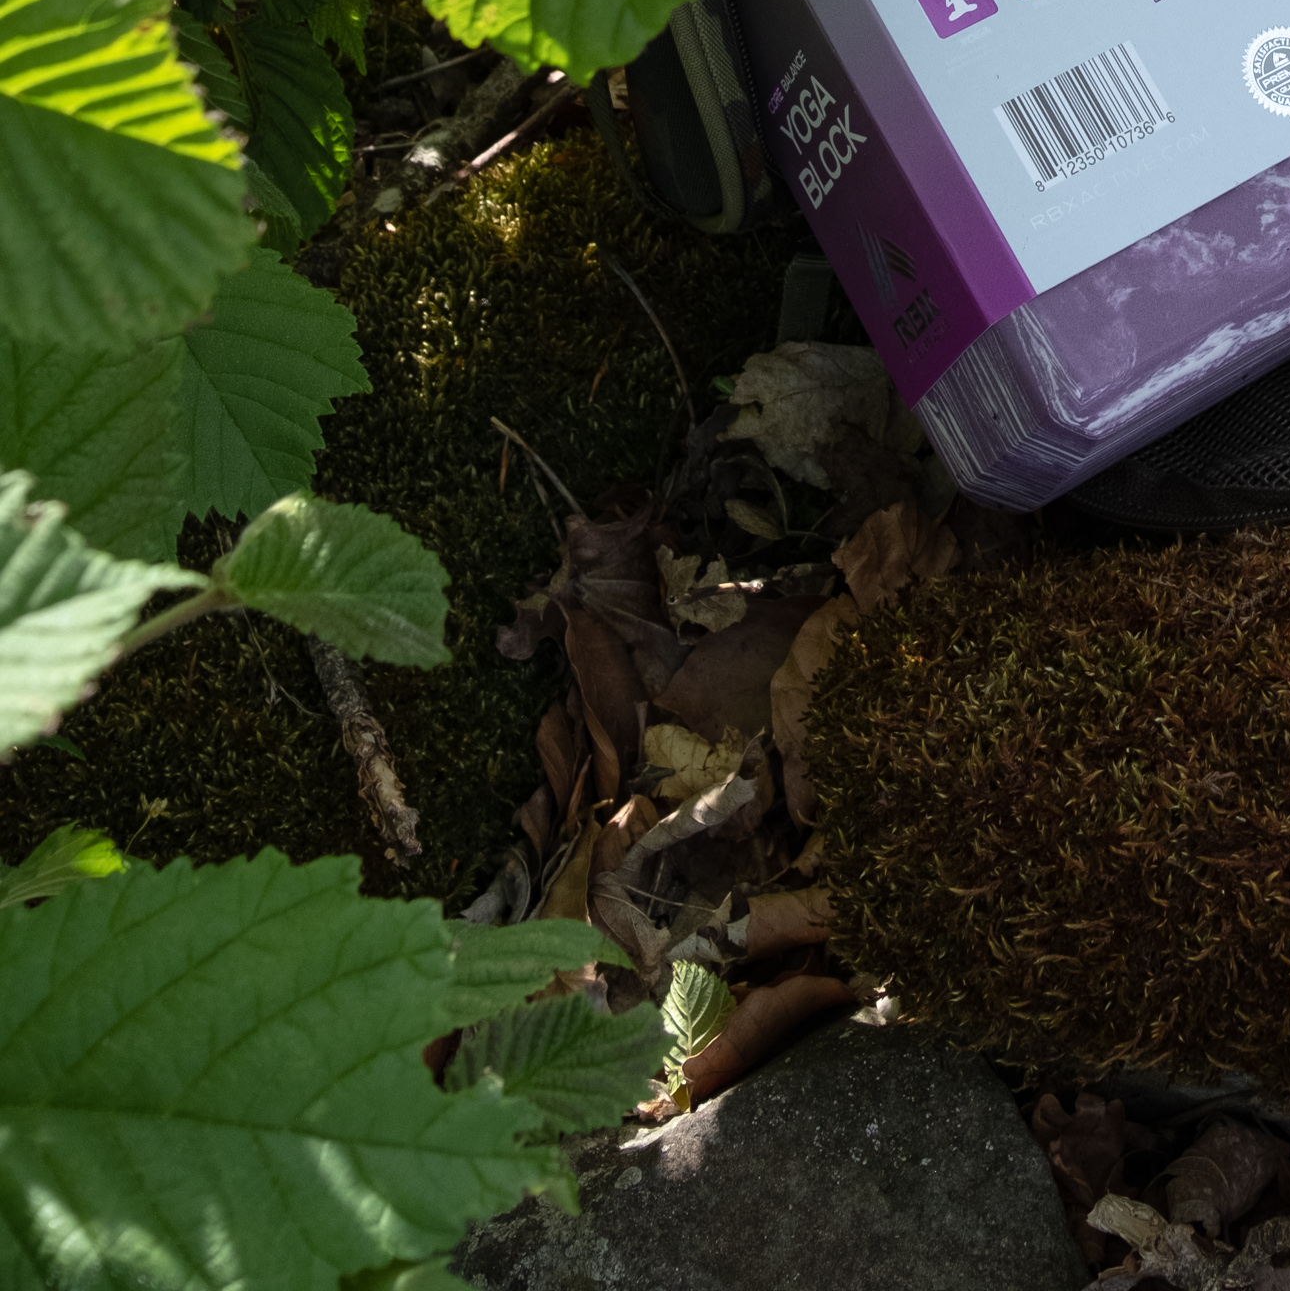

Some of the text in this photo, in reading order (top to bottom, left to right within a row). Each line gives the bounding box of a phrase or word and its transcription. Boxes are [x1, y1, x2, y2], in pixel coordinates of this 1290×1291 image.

[768, 49, 807, 114] CORE BALANCE
[779, 75, 836, 155] YOGA
[798, 103, 868, 210] BLOCK
[1034, 110, 1176, 194] 8 12350 10736 6
